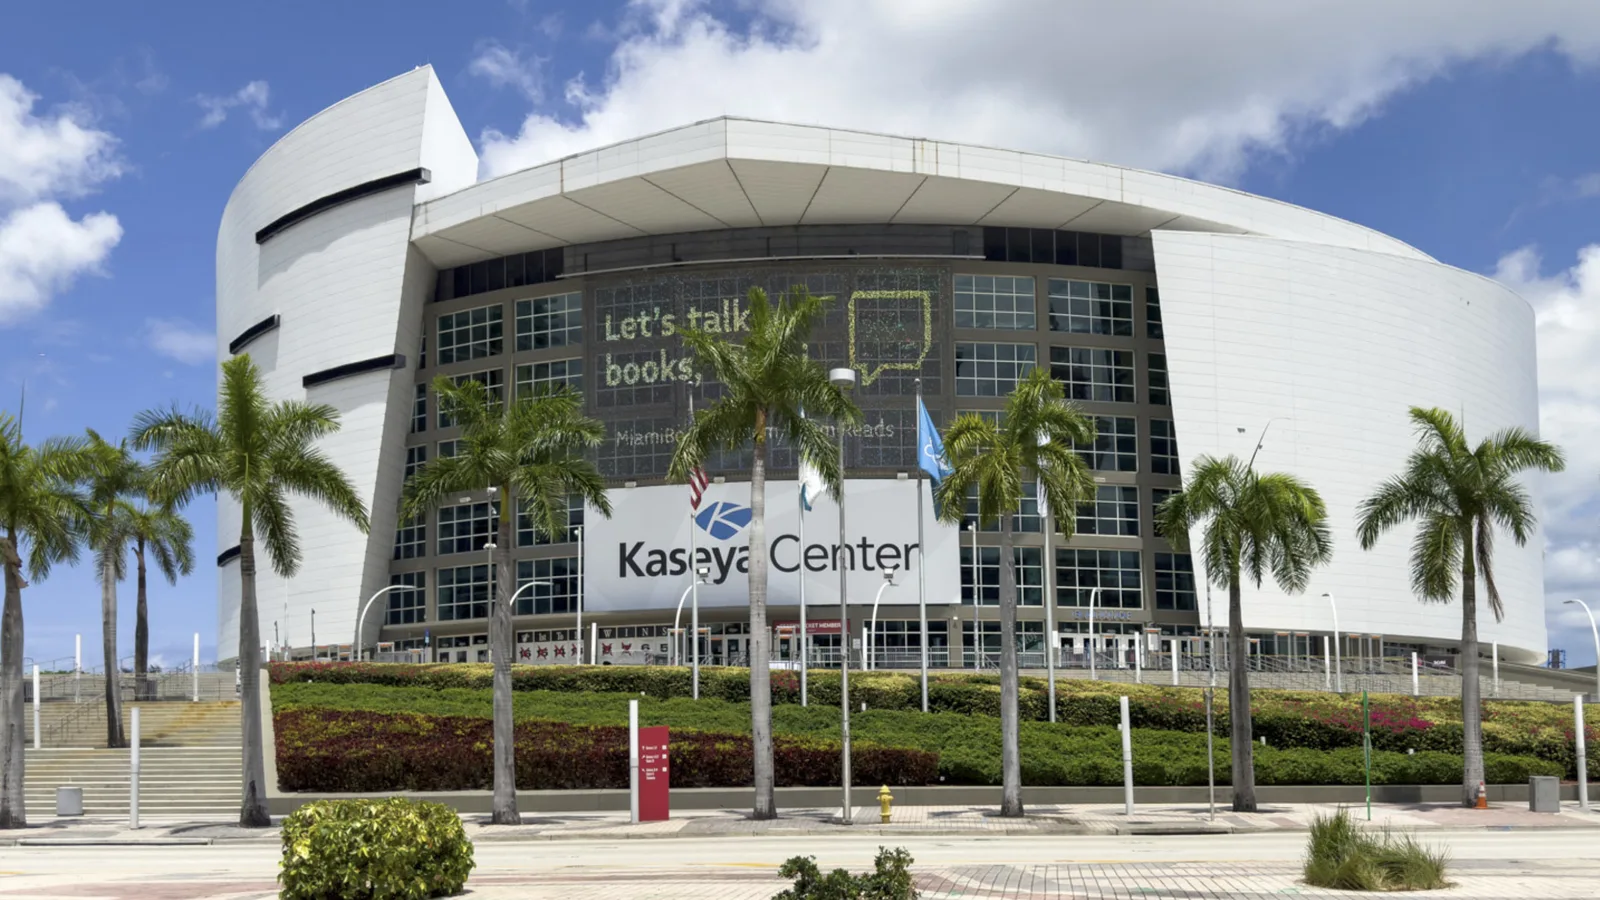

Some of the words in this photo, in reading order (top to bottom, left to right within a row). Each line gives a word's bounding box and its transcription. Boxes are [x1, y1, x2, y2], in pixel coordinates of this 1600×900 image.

[605, 306, 675, 341] Let's
[687, 299, 751, 333] talk
[606, 349, 702, 387] books,
[619, 541, 750, 585] Kaseya
[770, 534, 919, 573] Center
